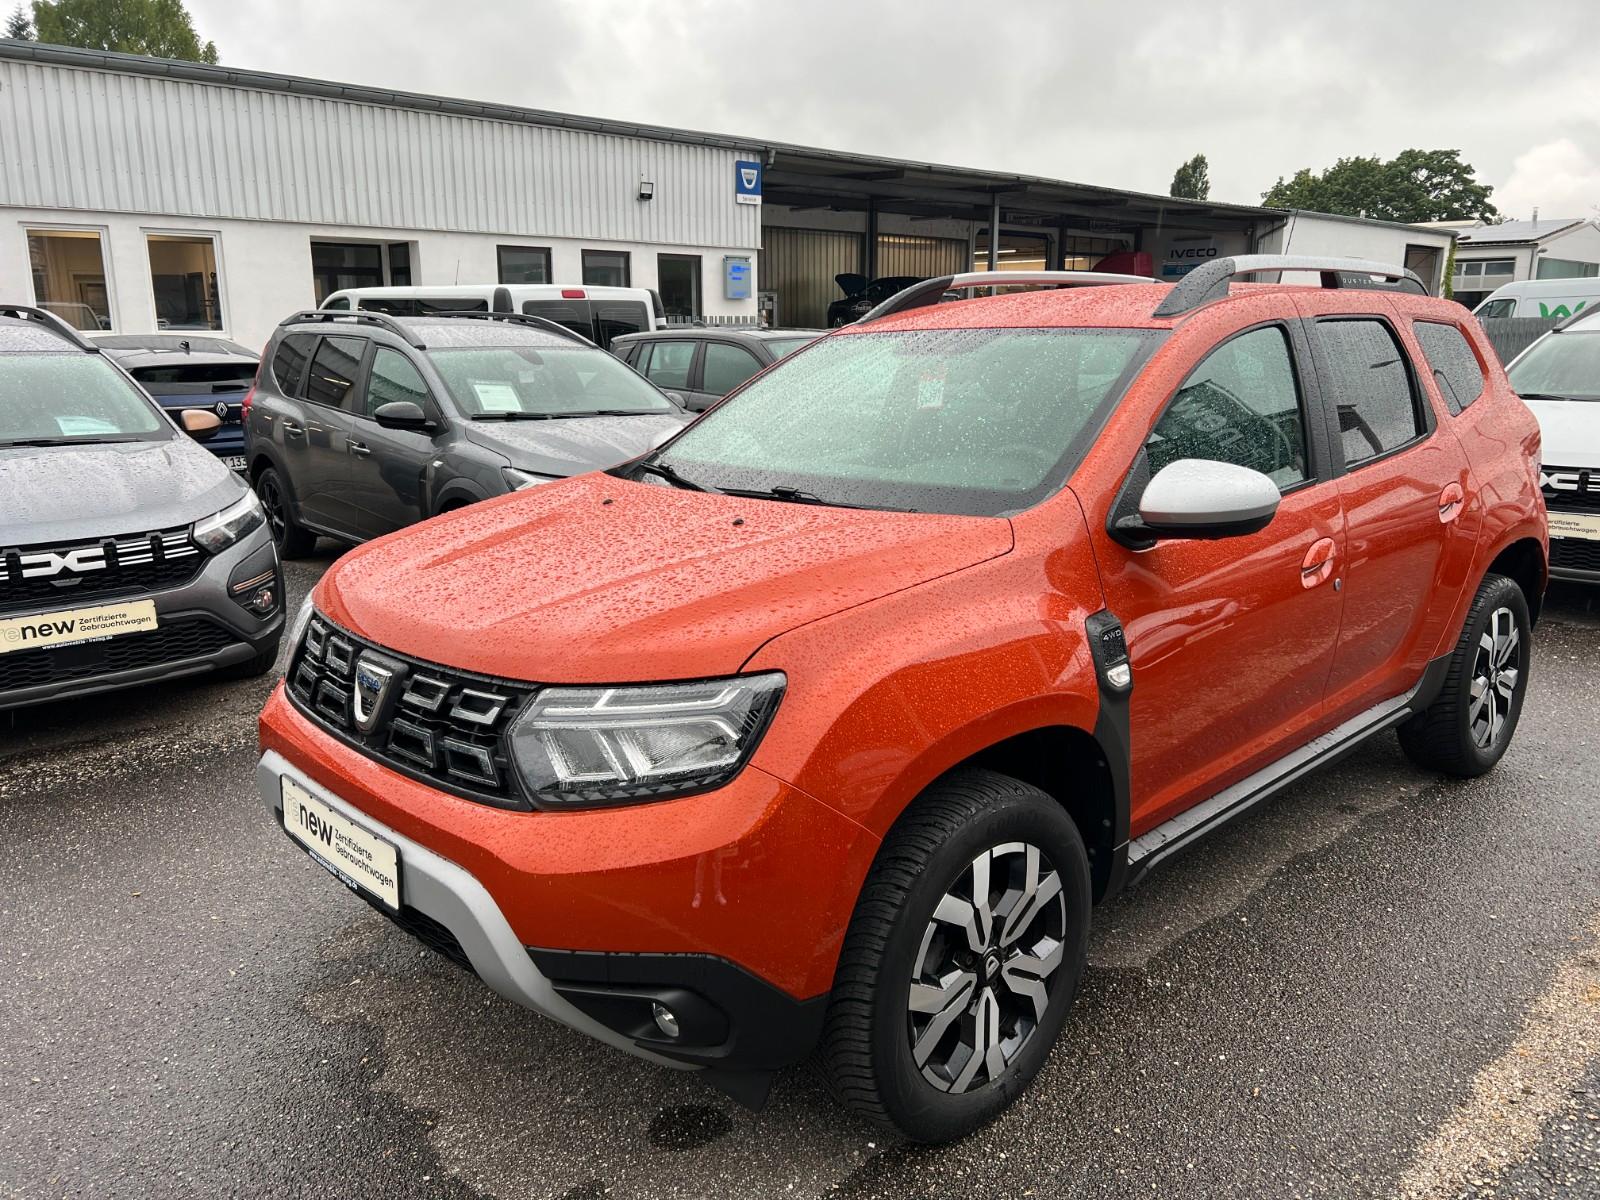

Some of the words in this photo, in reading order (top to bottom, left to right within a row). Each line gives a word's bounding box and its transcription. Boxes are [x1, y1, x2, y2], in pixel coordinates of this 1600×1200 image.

[1170, 247, 1217, 258] IVECO
[1342, 277, 1372, 285] DUSTER
[1548, 519, 1580, 527] ertifizierte
[1548, 525, 1598, 534] ebrauchtwagen
[79, 612, 127, 625] Zertifizierte
[80, 616, 151, 632] Gebrauchtwagen
[335, 828, 373, 862] Zertifizierte
[335, 842, 394, 889] Gebrauchtwagen
